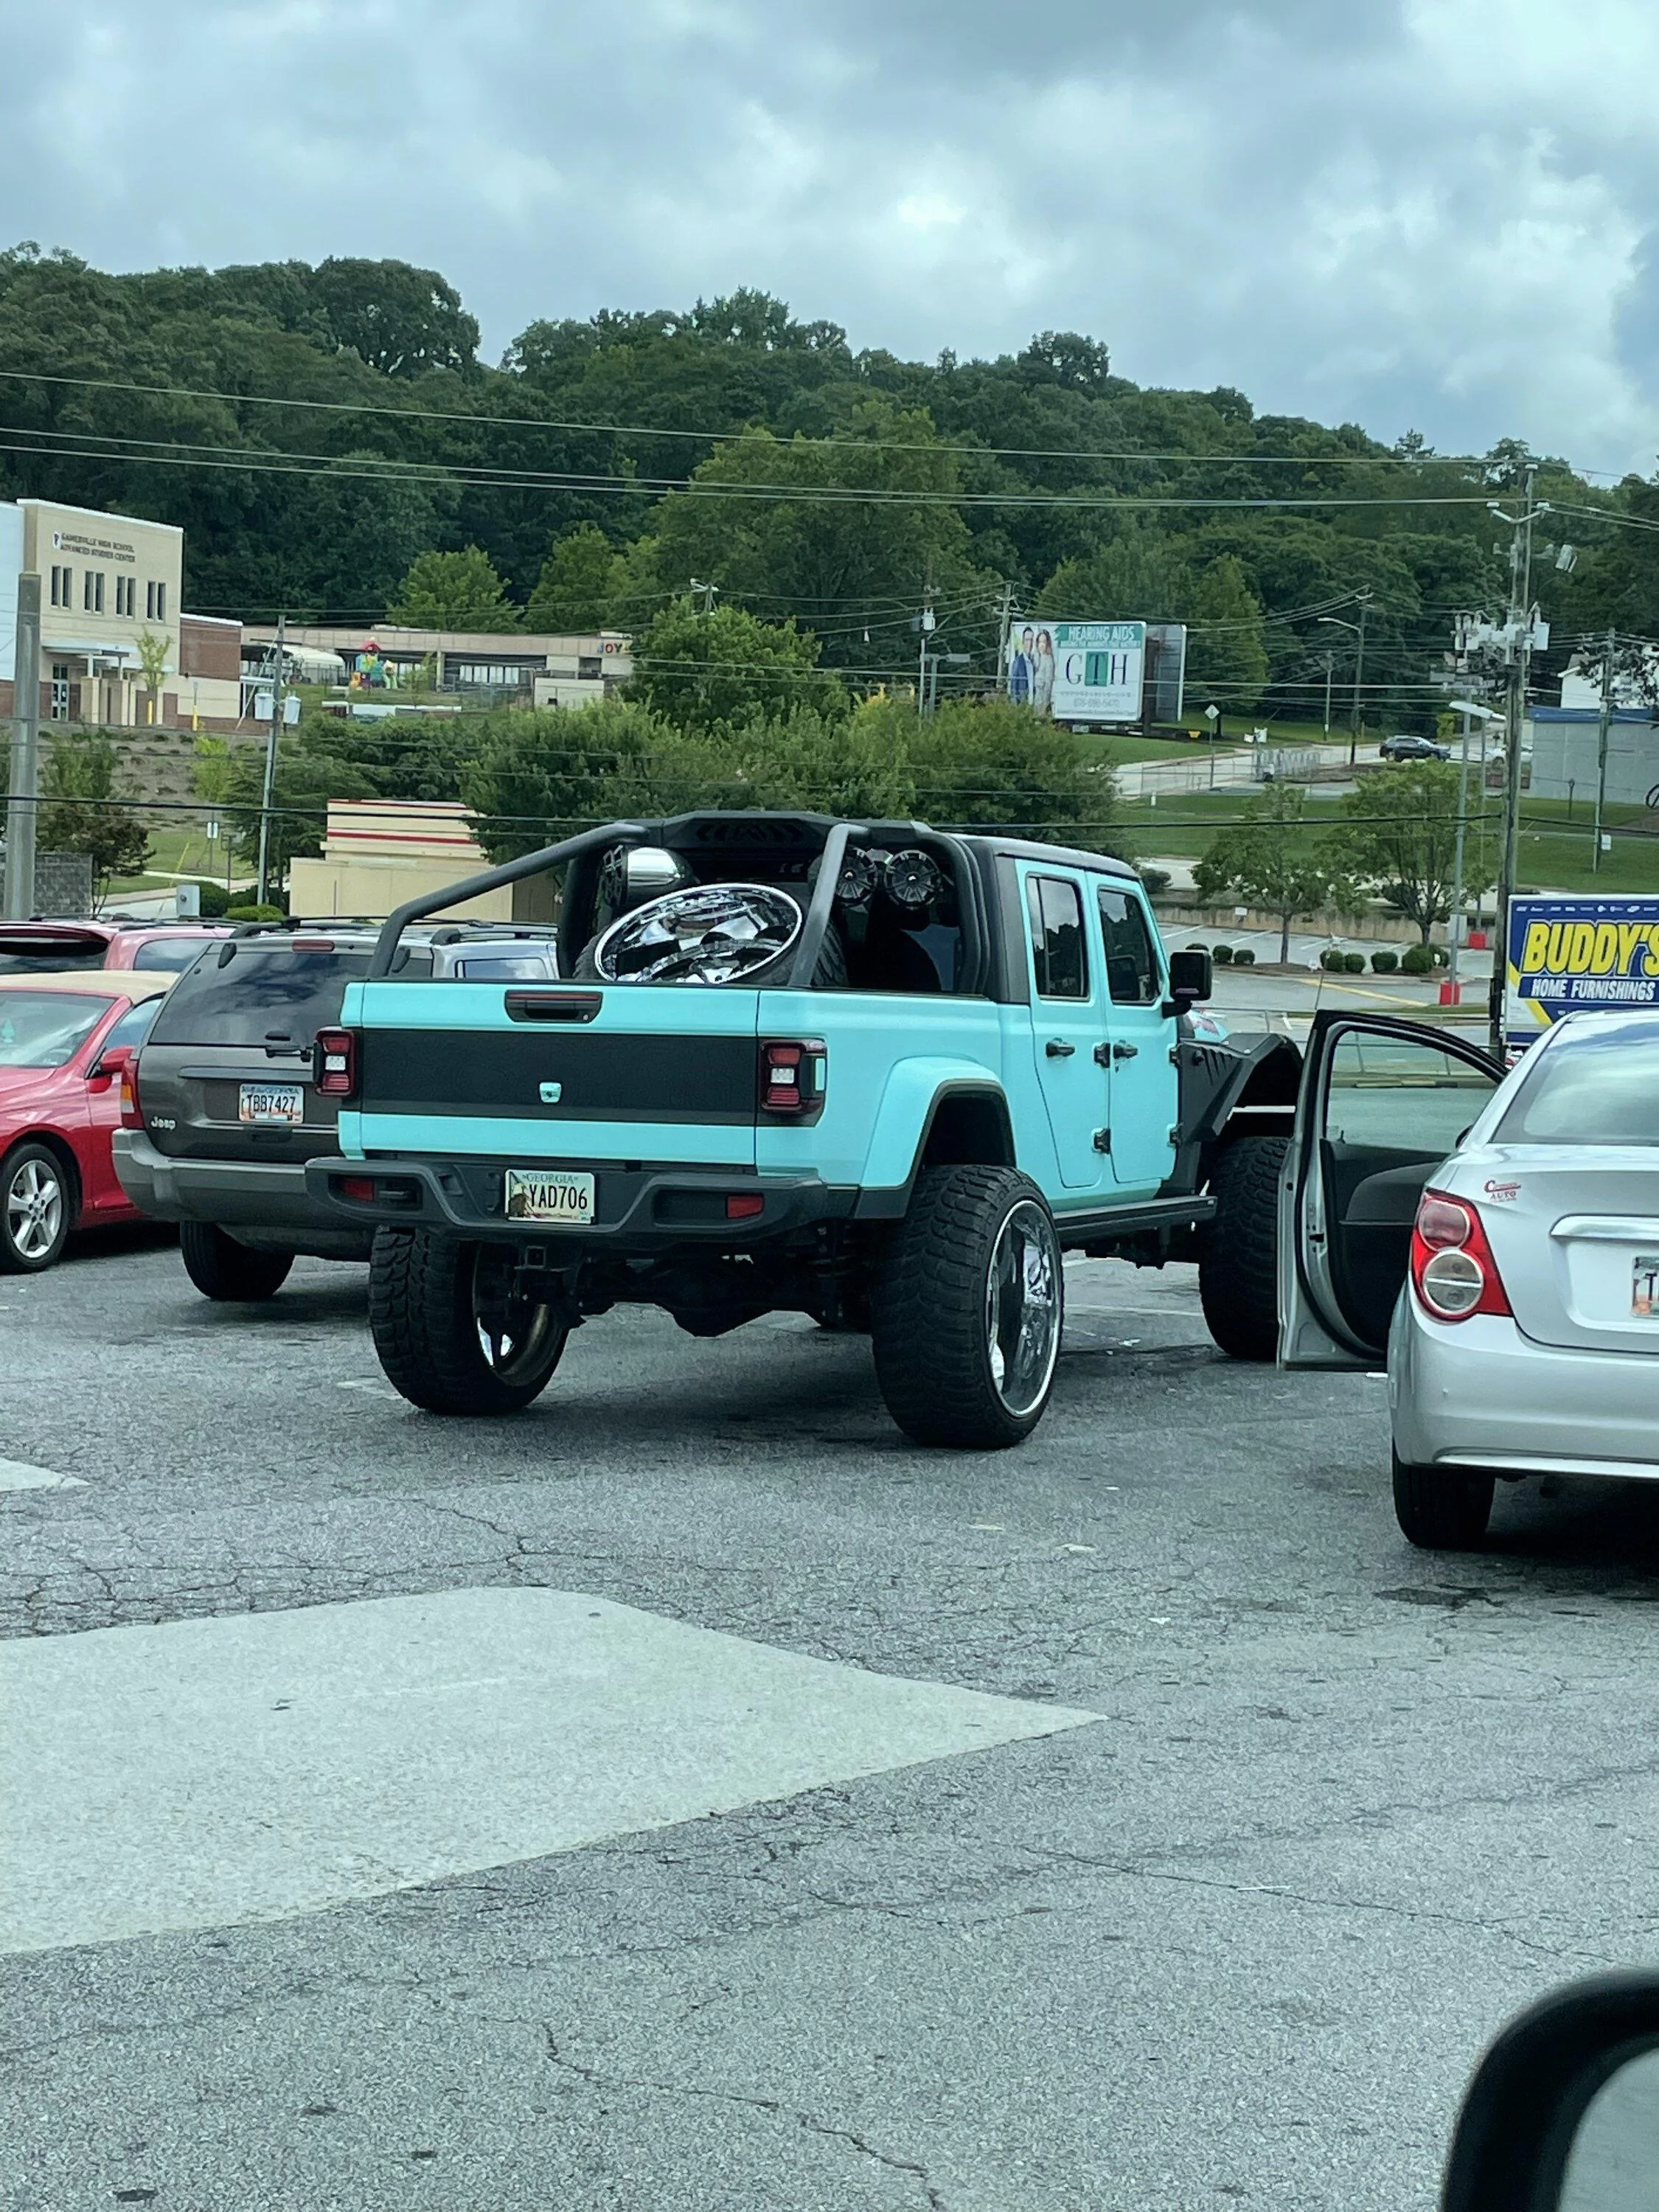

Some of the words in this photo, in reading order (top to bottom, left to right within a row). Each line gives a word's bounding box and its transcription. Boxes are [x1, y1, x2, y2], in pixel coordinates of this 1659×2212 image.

[1069, 625, 1110, 641] HEARING
[1111, 625, 1135, 641] AIDS
[1522, 922, 1659, 977] BUDDY'S
[1531, 978, 1568, 998] HOME
[1571, 980, 1656, 1001] FURNISHINGS
[247, 1094, 296, 1113] TBB7427
[151, 1116, 175, 1130] Jeep
[526, 1172, 577, 1184] GEORGIA
[529, 1184, 588, 1210] YAD706
